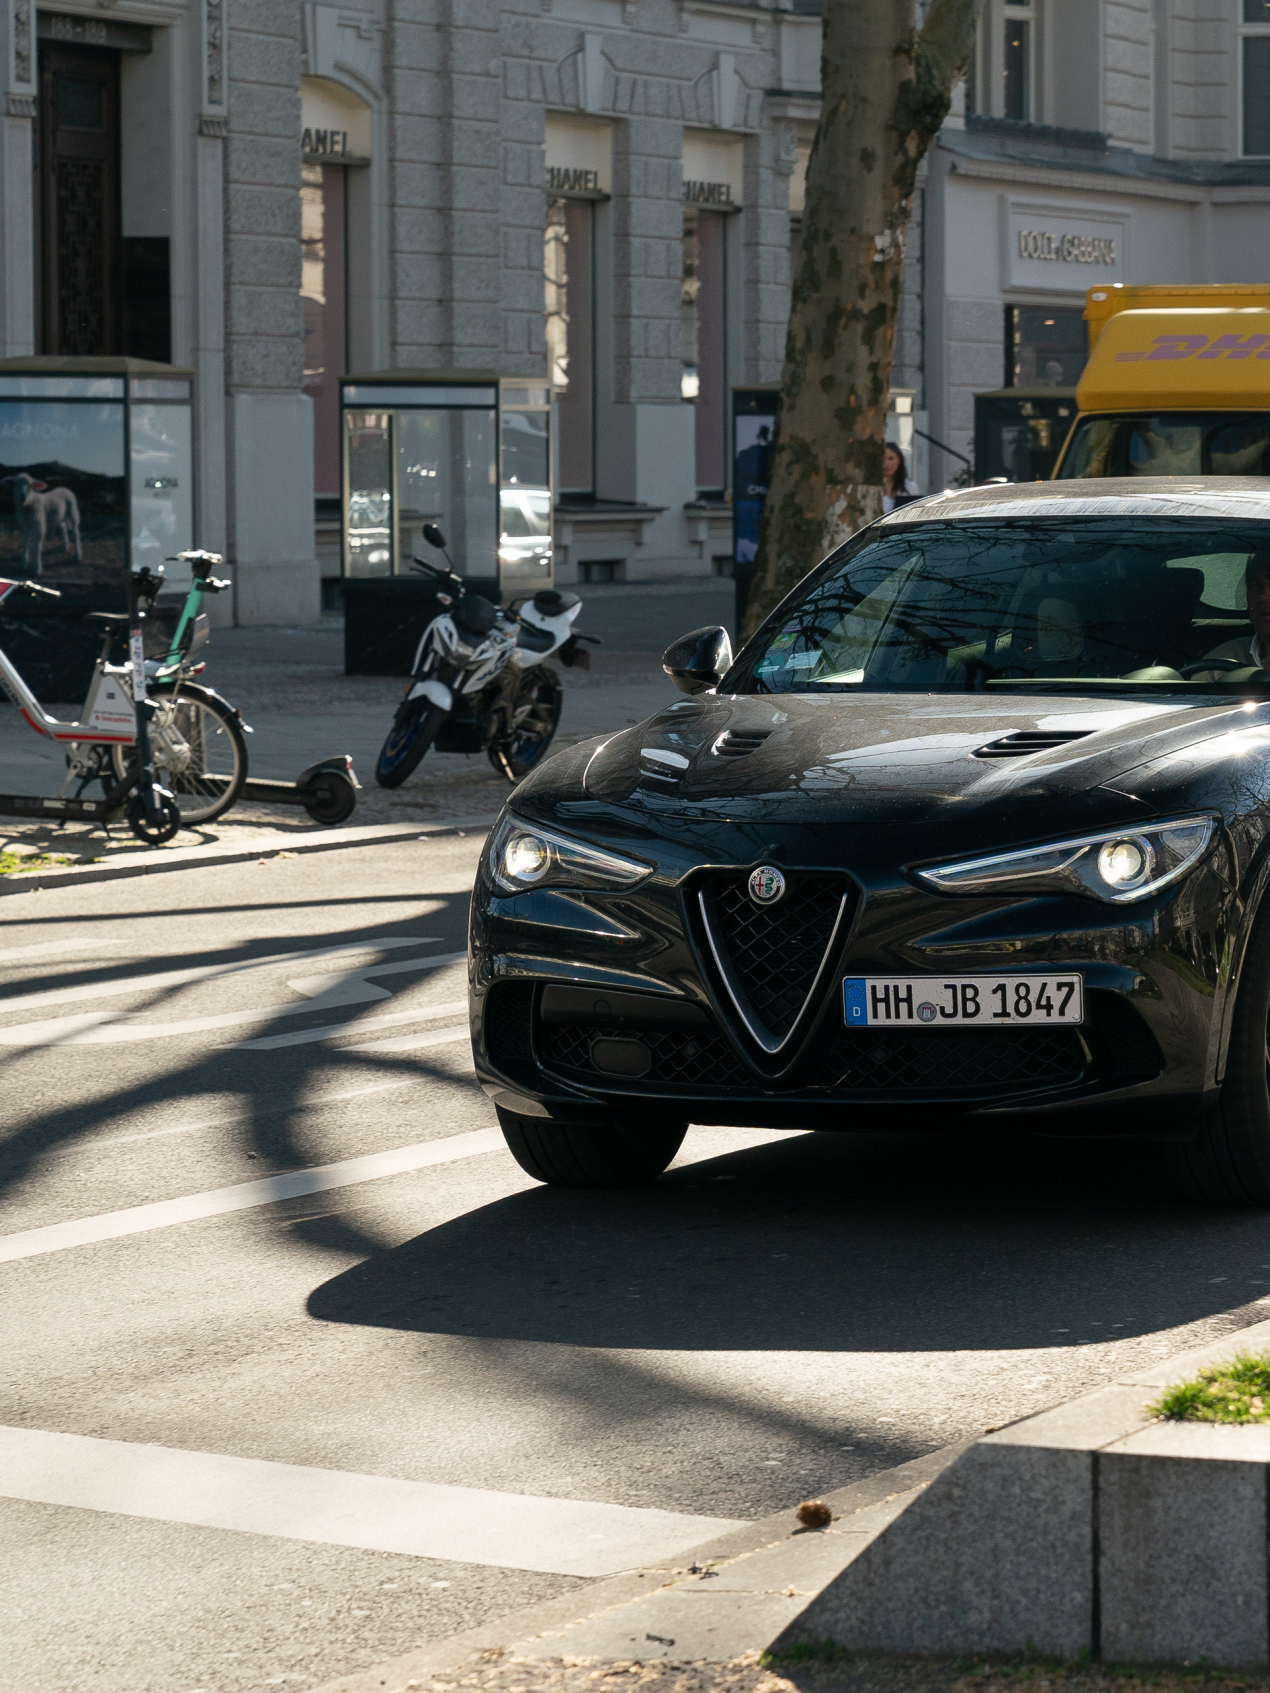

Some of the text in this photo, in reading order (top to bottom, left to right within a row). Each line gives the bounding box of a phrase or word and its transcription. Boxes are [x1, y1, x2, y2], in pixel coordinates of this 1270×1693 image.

[853, 1006, 861, 1017] D
[870, 982, 1075, 1019] HH JB 1847
